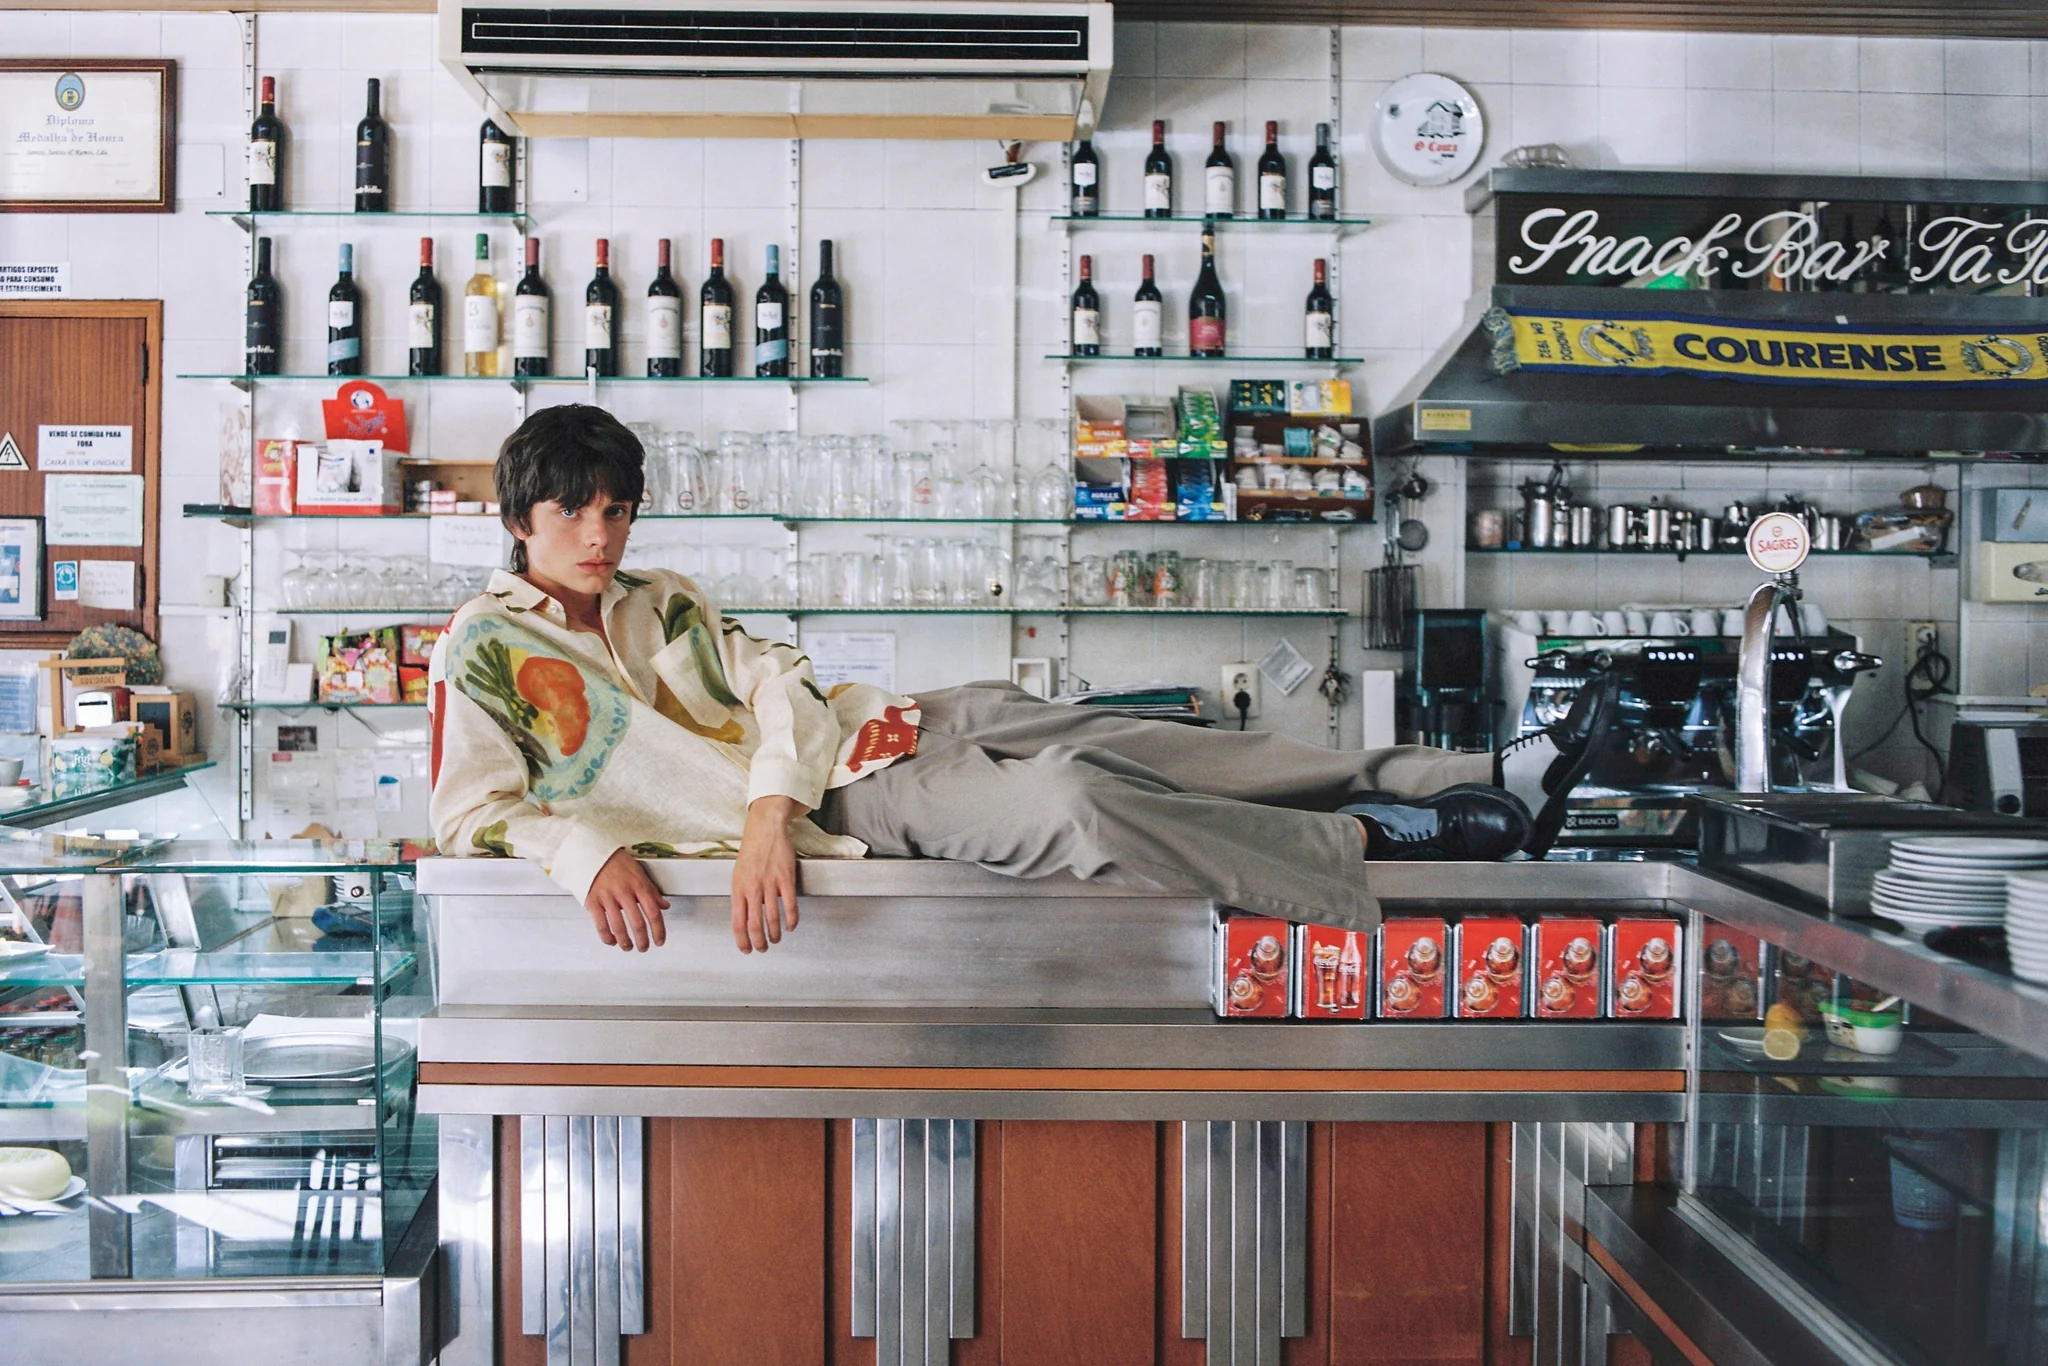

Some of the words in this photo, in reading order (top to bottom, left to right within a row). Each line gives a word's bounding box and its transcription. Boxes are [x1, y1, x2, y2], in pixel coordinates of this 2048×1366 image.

[45, 114, 95, 126] Diploma
[71, 132, 84, 142] de
[86, 132, 124, 142] Honra
[1508, 207, 1743, 278] Snack
[1731, 210, 1891, 280] Bar
[1909, 215, 2004, 283] Tá
[1550, 320, 1574, 361] FUNDADO
[1673, 333, 1947, 372] COURENSE
[48, 430, 78, 438] VENDE-SE
[79, 430, 105, 438] COMIDA
[44, 459, 67, 467] CAIXA
[1758, 537, 1799, 553] SAGRES
